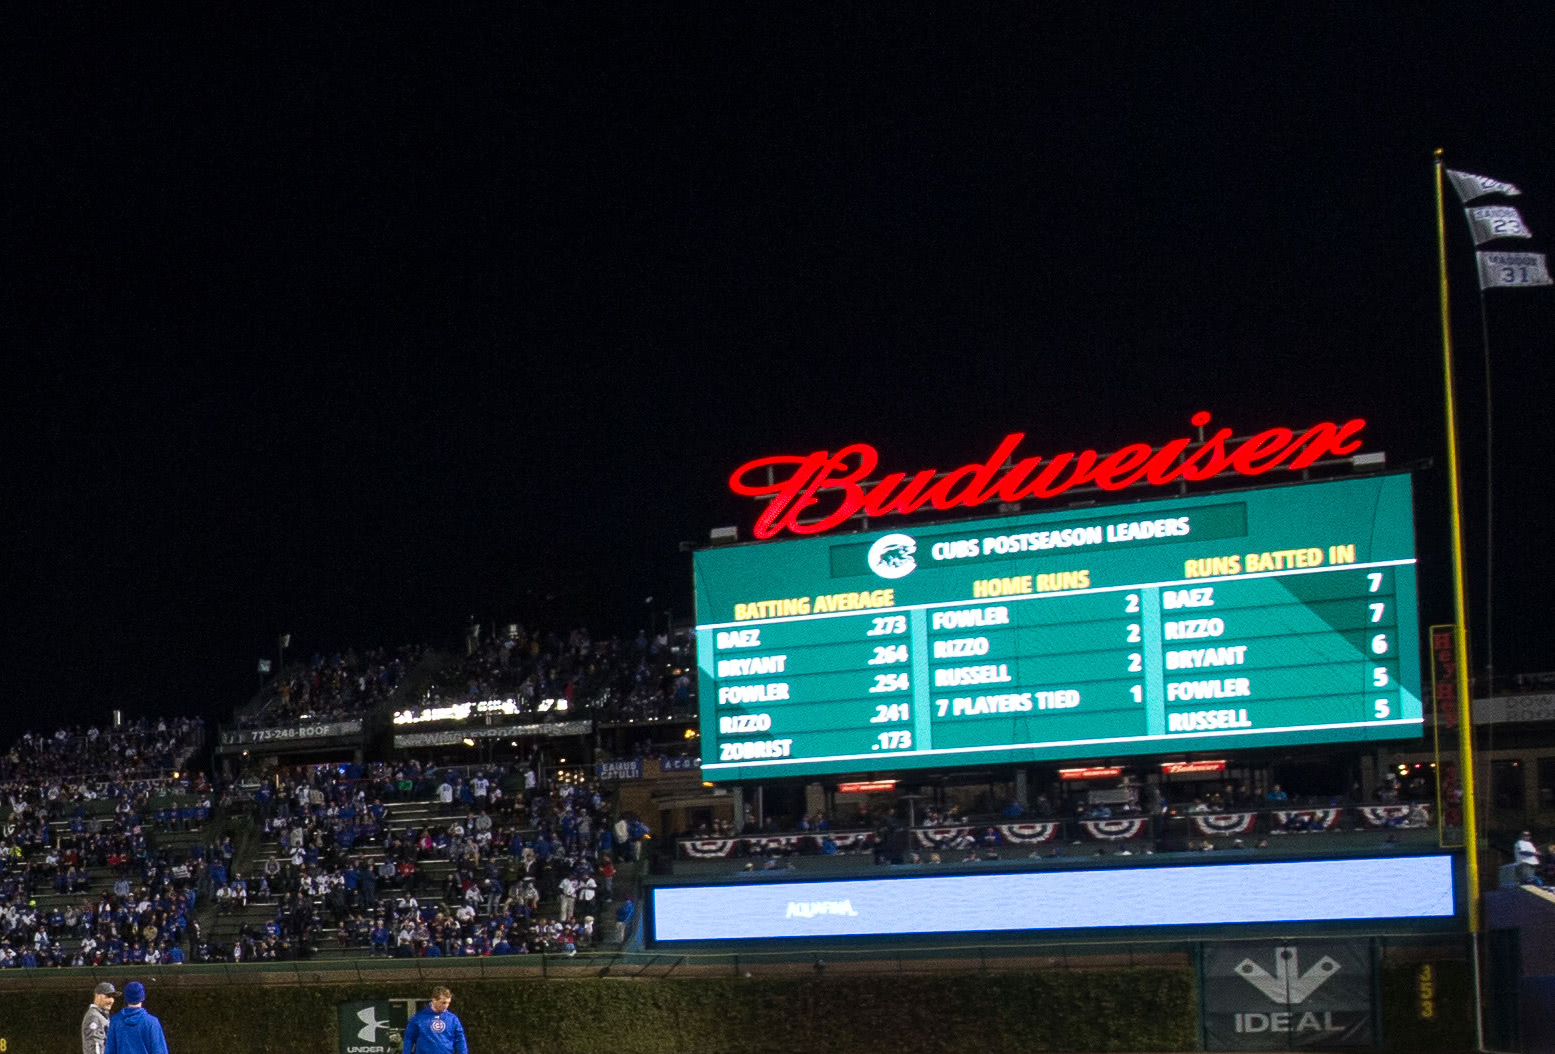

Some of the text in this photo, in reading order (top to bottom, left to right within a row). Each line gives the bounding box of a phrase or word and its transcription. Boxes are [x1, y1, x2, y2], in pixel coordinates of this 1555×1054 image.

[1494, 219, 1521, 233] 23
[1503, 267, 1529, 283] 31
[728, 410, 1367, 539] Budweiser
[932, 516, 1190, 561] CUBS POSTSEASON LEADERS
[1184, 544, 1356, 579] RUNS BATTED IN
[973, 569, 1090, 598] HOME RUNS
[1163, 572, 1383, 609] BAEZ 7
[734, 588, 895, 621] BATTING AVERAGE
[932, 594, 1140, 630] FOWLER 2
[1164, 603, 1385, 640] RIZZO 7
[716, 615, 907, 649] BAEZ .273
[933, 624, 1141, 659] RIZZO 2
[717, 644, 909, 678] BRYANT .264
[1166, 634, 1388, 670] BRYANT 6
[935, 652, 1142, 687] RUSSELL 2
[1167, 667, 1388, 701] FOWLER 5
[718, 673, 910, 705] FOWLER .254
[936, 684, 1142, 717] 7 PLAYERS TIED 1
[719, 703, 910, 734] RIZZO .241
[1168, 698, 1389, 732] RUSSELL 5
[251, 725, 330, 741] 773-248-ROOF
[719, 731, 912, 761] ZOBRIST .173
[1234, 1011, 1345, 1033] IDEAL
